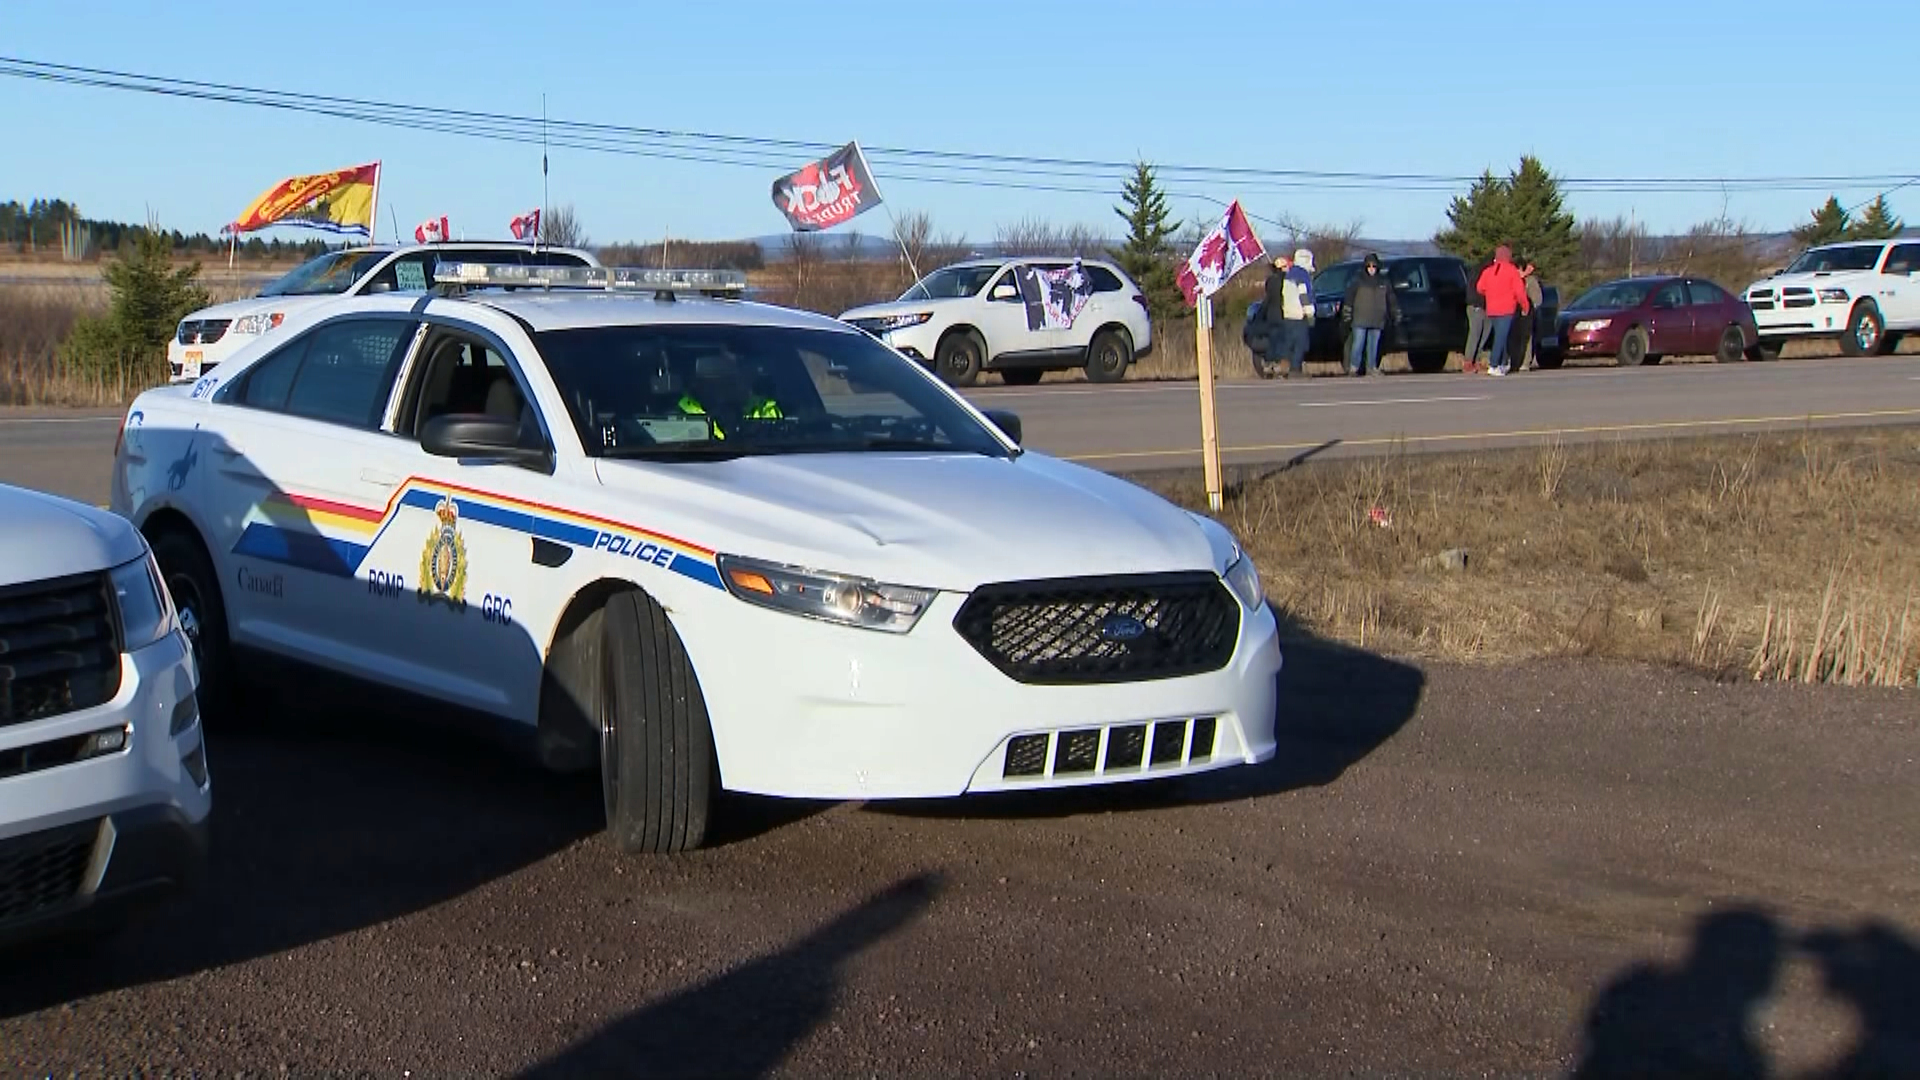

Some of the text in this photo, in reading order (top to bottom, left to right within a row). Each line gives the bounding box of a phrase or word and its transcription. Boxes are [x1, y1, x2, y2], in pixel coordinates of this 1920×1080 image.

[595, 531, 673, 568] POLICE
[368, 569, 404, 599] RCMP
[482, 593, 512, 625] GRC
